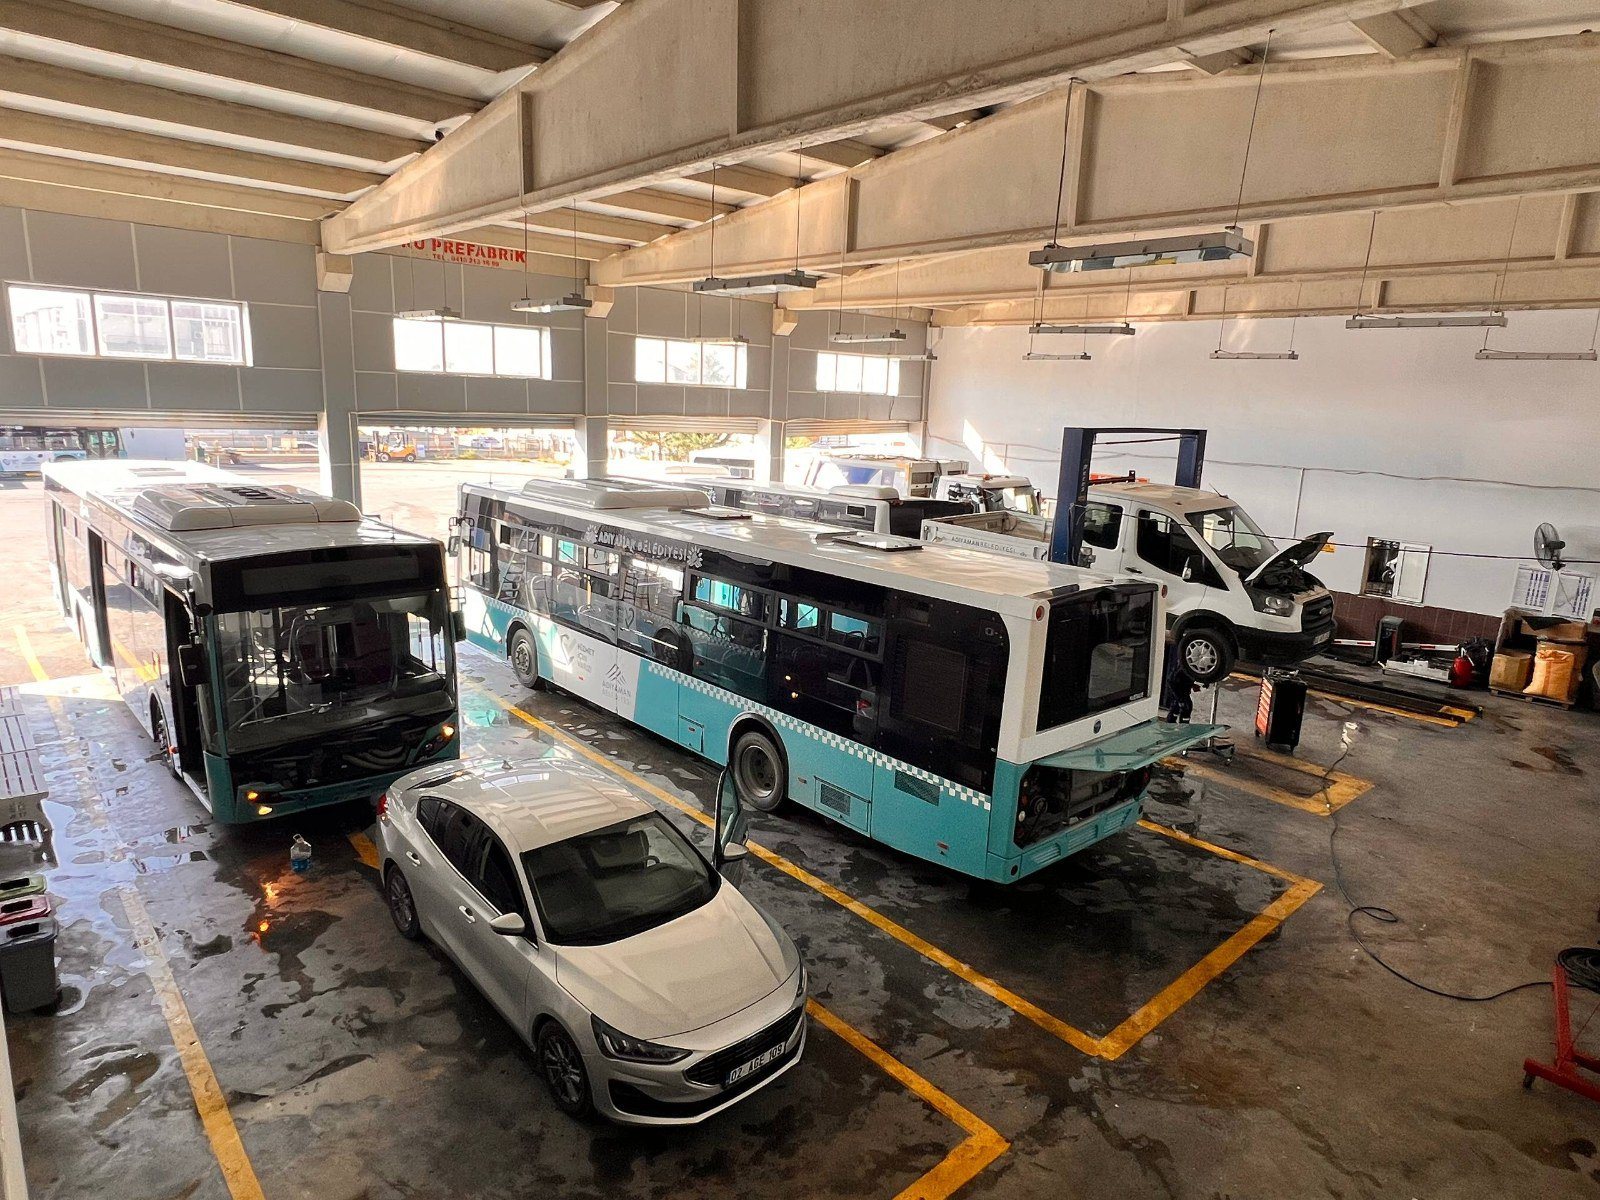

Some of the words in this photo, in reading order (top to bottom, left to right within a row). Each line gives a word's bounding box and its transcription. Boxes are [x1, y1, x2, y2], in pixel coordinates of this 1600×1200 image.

[731, 1067, 743, 1081] 02
[748, 1055, 765, 1071] AGE
[769, 1045, 783, 1060] 109
